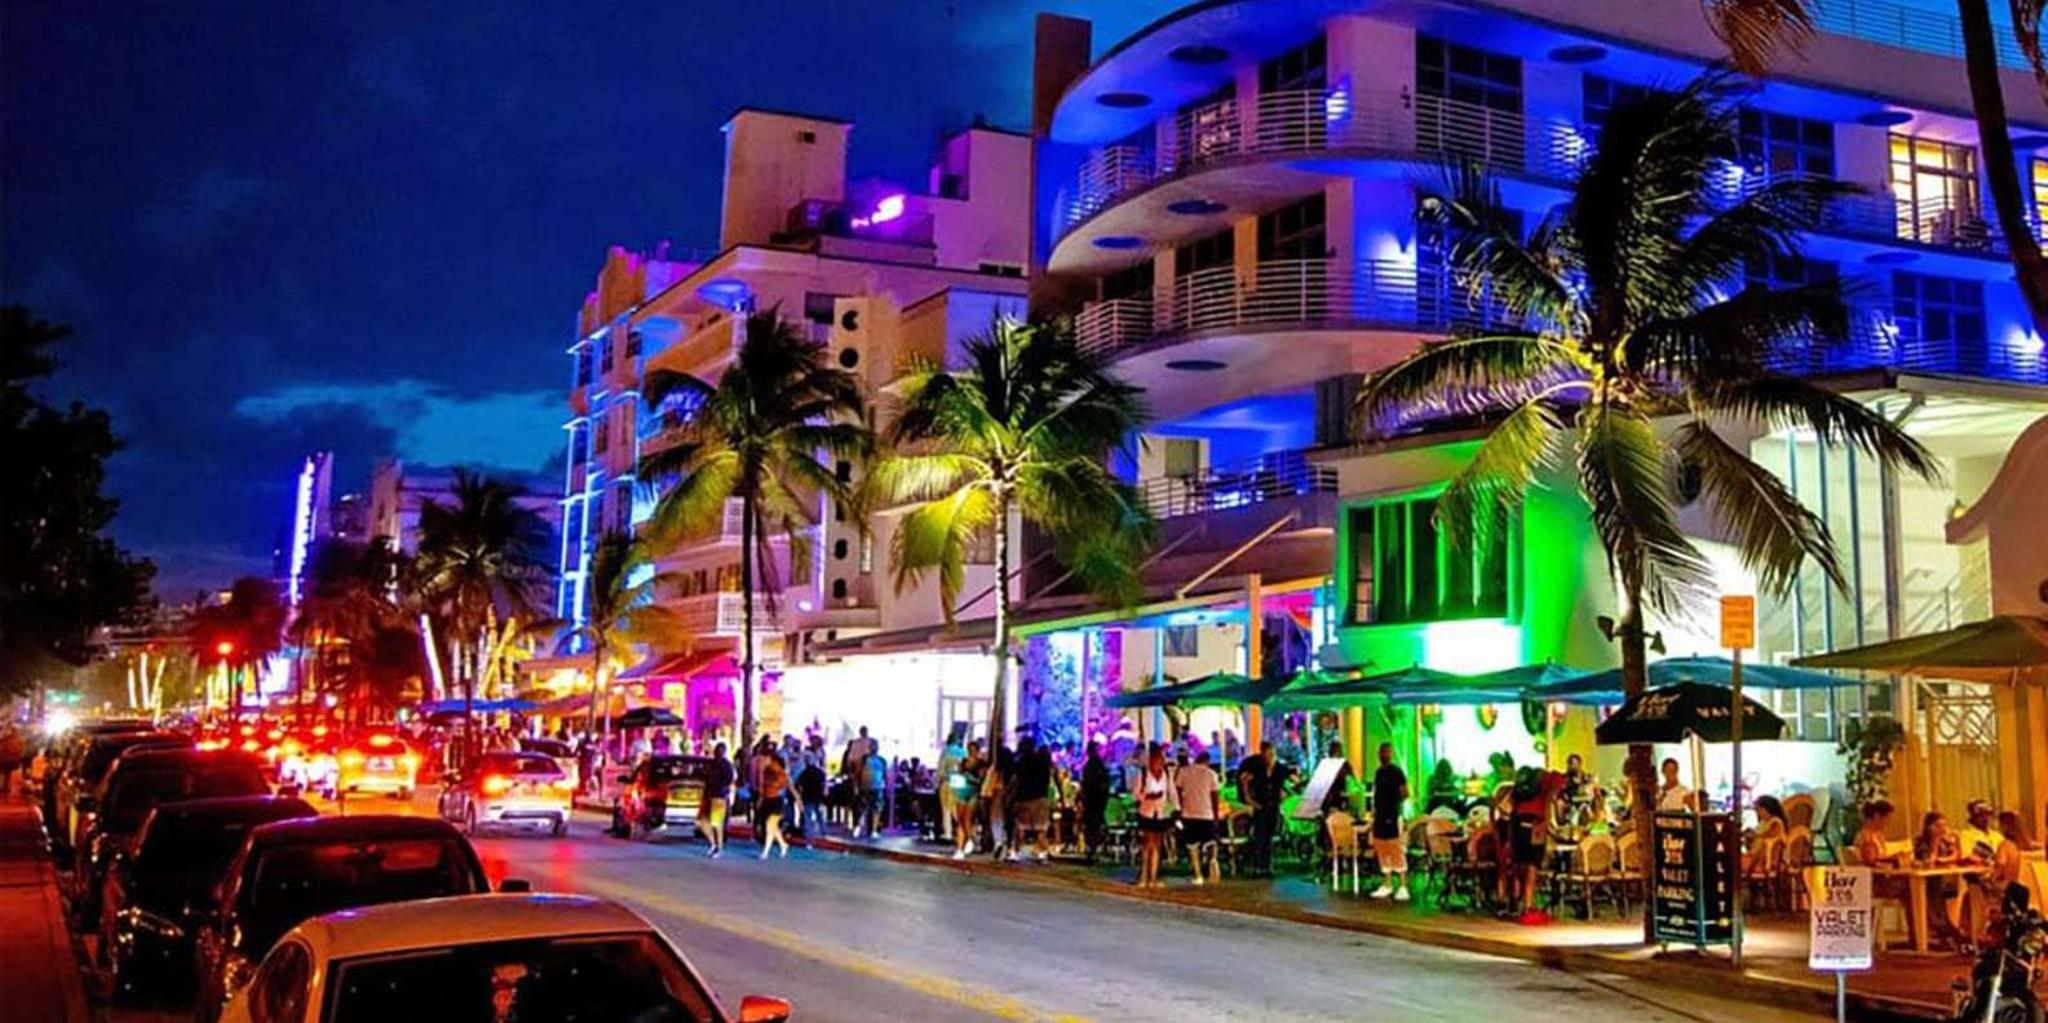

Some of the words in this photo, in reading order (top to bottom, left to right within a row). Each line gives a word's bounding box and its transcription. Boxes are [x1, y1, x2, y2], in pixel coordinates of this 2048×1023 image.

[1696, 705, 1756, 717] VALT
[1715, 821, 1726, 913] VALET
[1662, 868, 1689, 883] VALET
[1657, 885, 1695, 902] PARKING
[1814, 909, 1868, 925] VALET
[1817, 923, 1866, 938] PARKING
